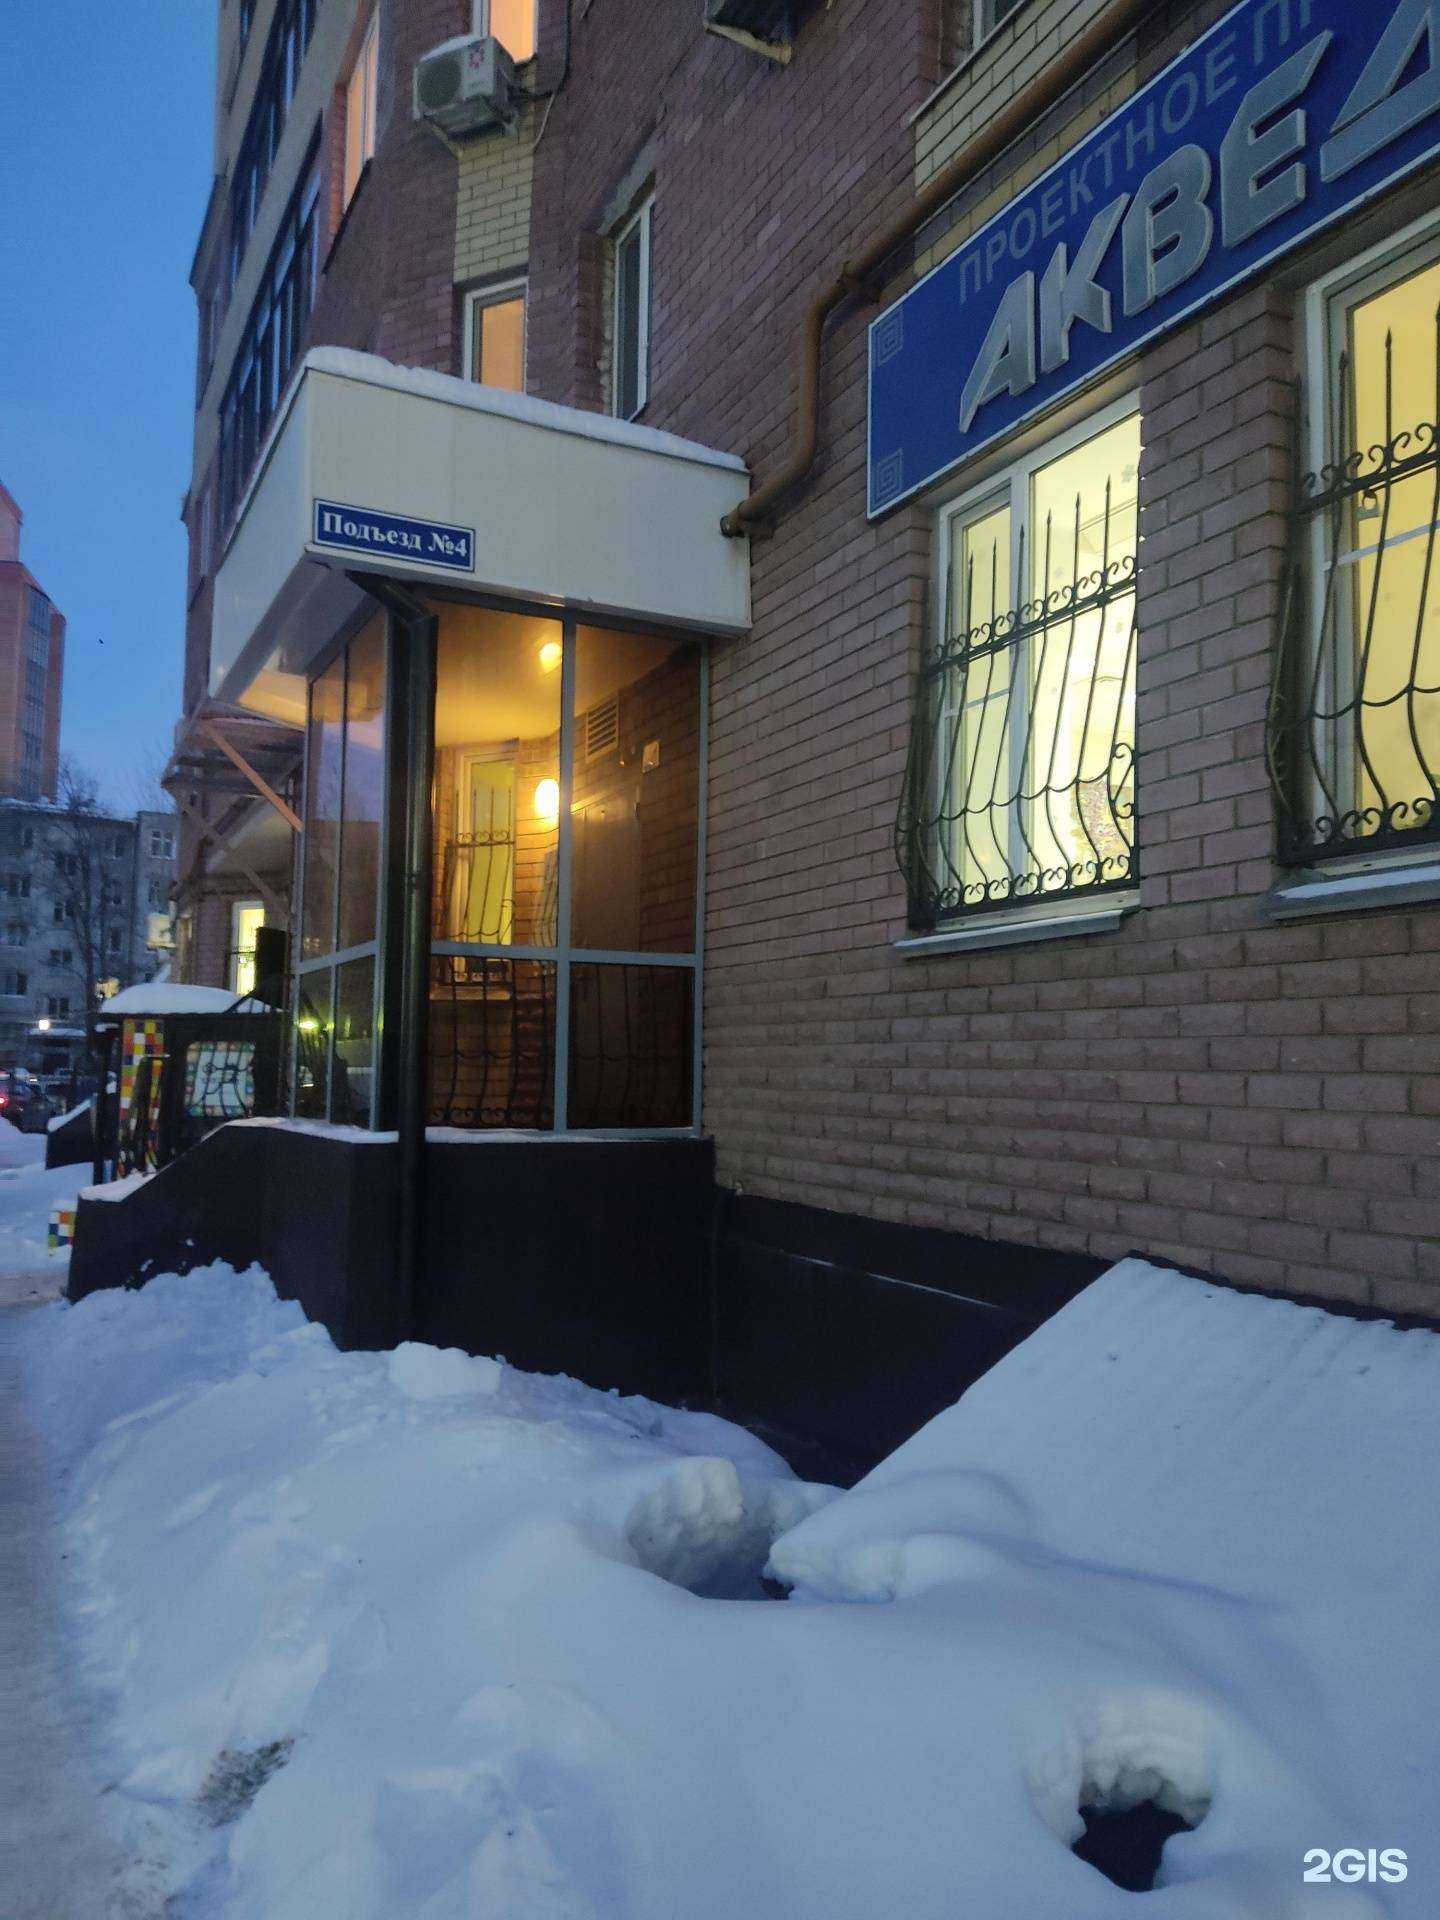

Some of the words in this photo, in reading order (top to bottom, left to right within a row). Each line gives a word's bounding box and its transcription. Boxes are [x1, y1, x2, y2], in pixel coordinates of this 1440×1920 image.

[960, 30, 1237, 304] ПРОЕКТНОЕ
[322, 511, 421, 551] Подъезд
[428, 532, 468, 557] №4
